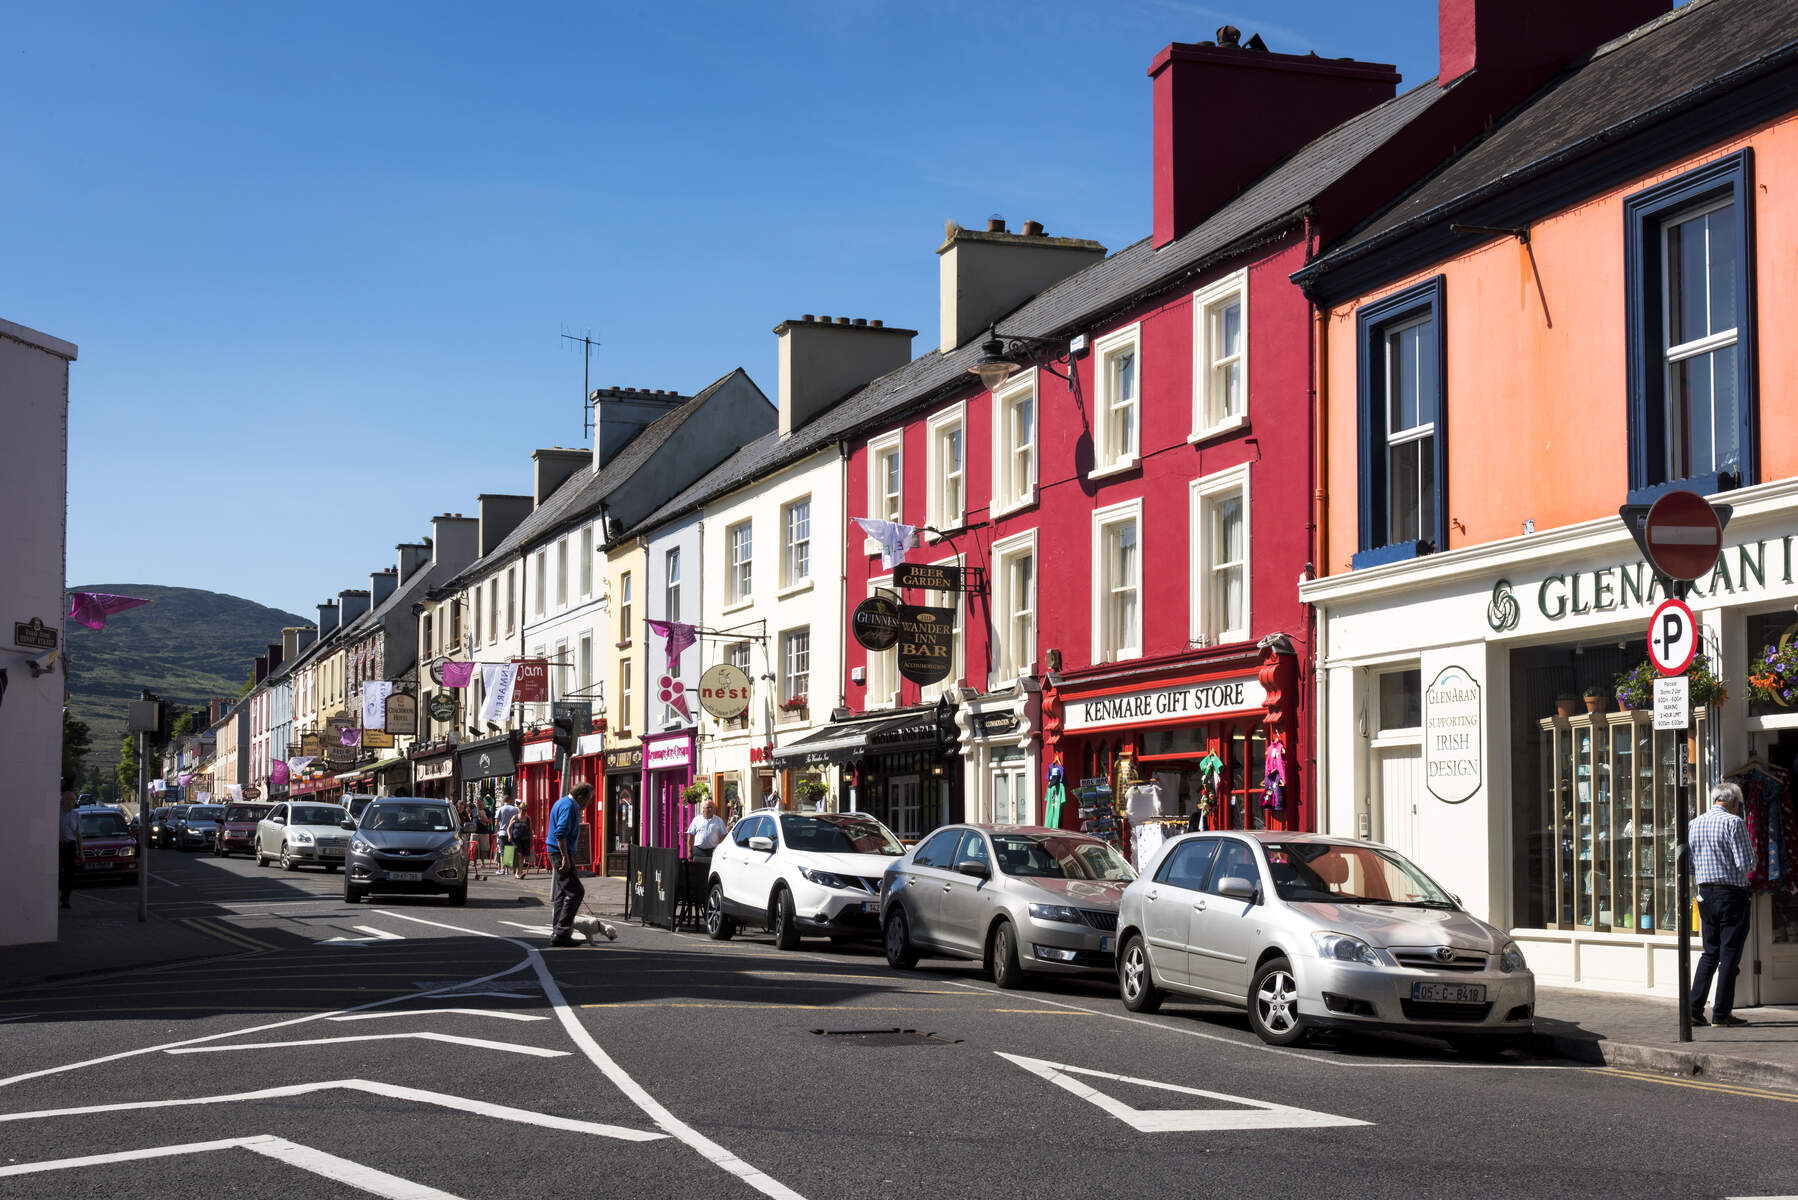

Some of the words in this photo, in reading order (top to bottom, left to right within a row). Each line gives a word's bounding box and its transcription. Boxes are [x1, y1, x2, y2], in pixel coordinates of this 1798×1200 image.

[911, 567, 944, 578] BEER
[1538, 539, 1766, 620] GLENAN
[903, 575, 951, 588] GARDEN
[902, 621, 950, 635] WANDER
[915, 633, 937, 644] INN
[1663, 613, 1683, 661] P
[903, 643, 948, 657] BAR
[517, 665, 544, 681] jam
[702, 687, 748, 699] nest
[1085, 695, 1152, 723] KENMARE
[1156, 690, 1191, 714] GIFT
[1194, 682, 1245, 710] STORE
[1429, 715, 1478, 728] SUPPORTING
[1437, 733, 1470, 751] IRISH
[750, 740, 773, 763] nest
[1429, 759, 1479, 777] DESIGN
